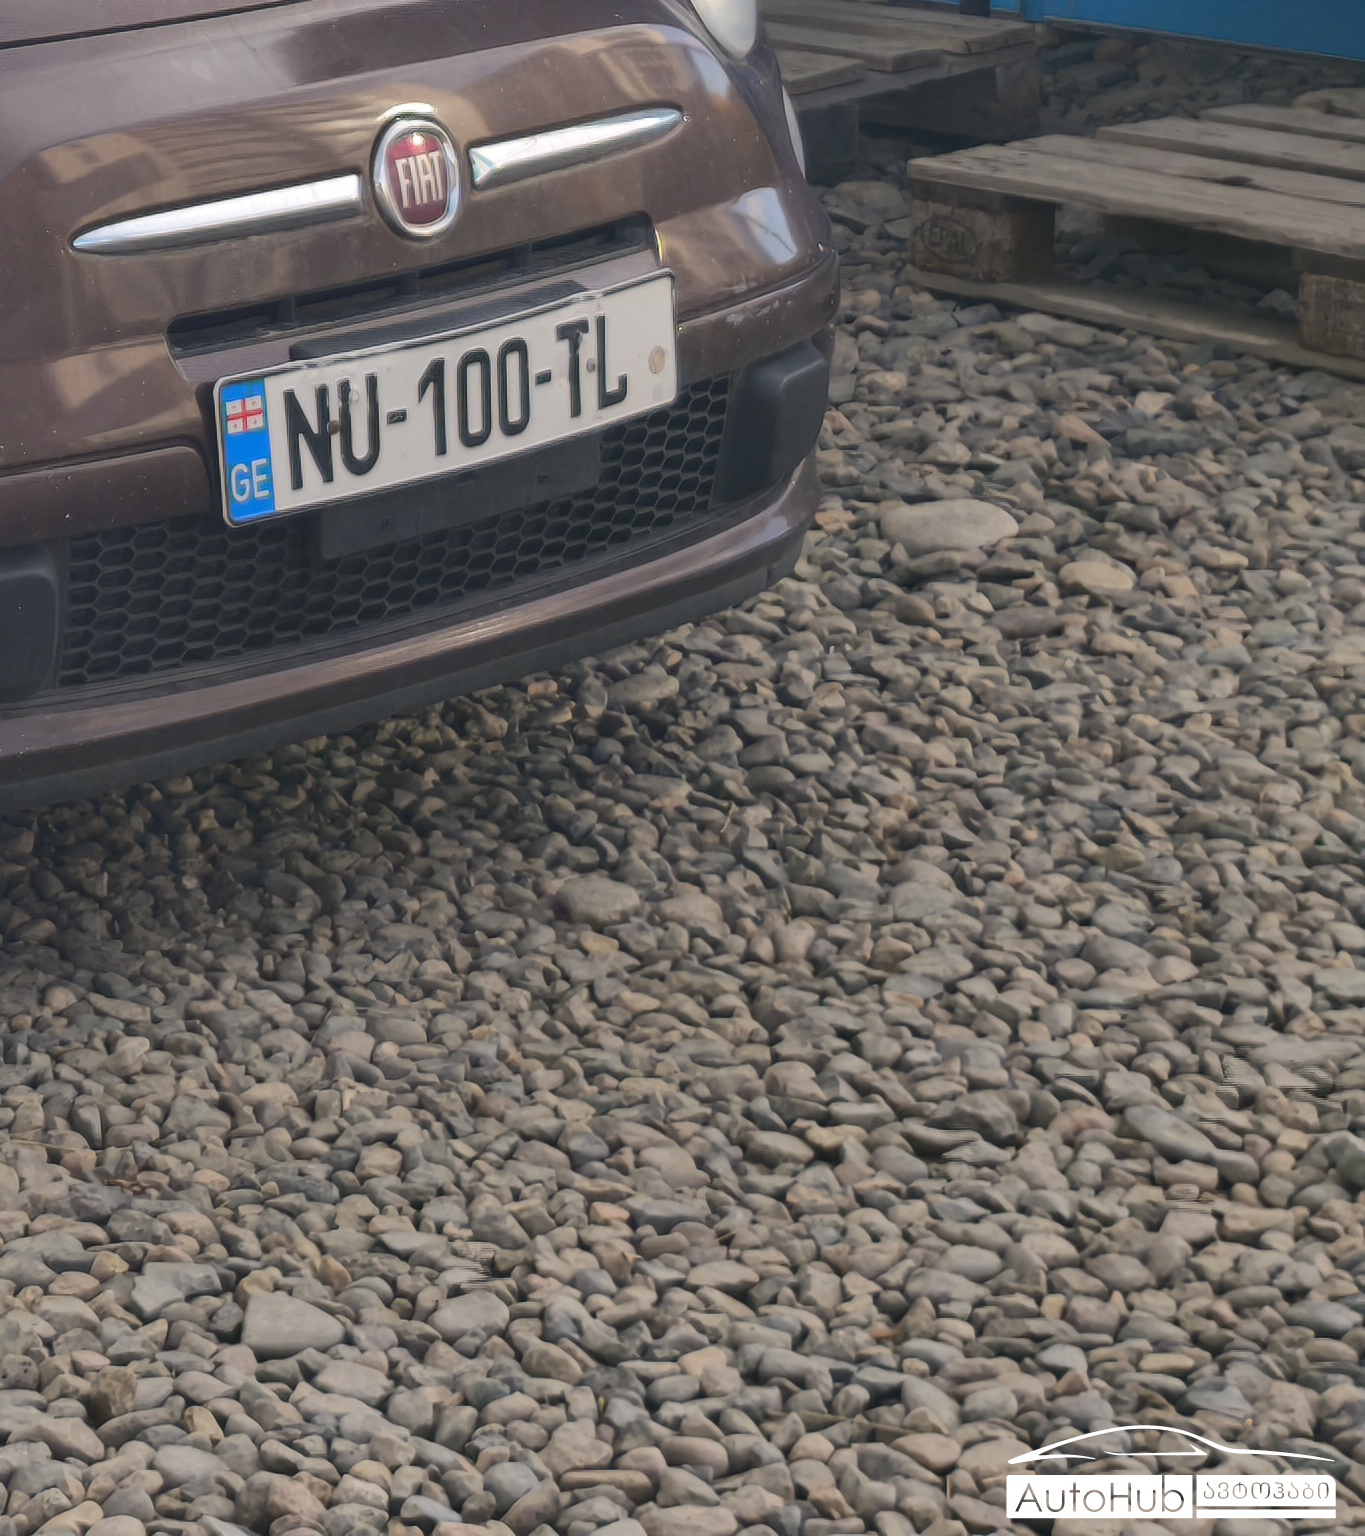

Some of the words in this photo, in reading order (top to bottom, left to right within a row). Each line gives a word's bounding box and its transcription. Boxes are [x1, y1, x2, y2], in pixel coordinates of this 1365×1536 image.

[395, 150, 444, 209] FIAT
[283, 313, 628, 491] NU-100-TL
[231, 458, 269, 503] GE
